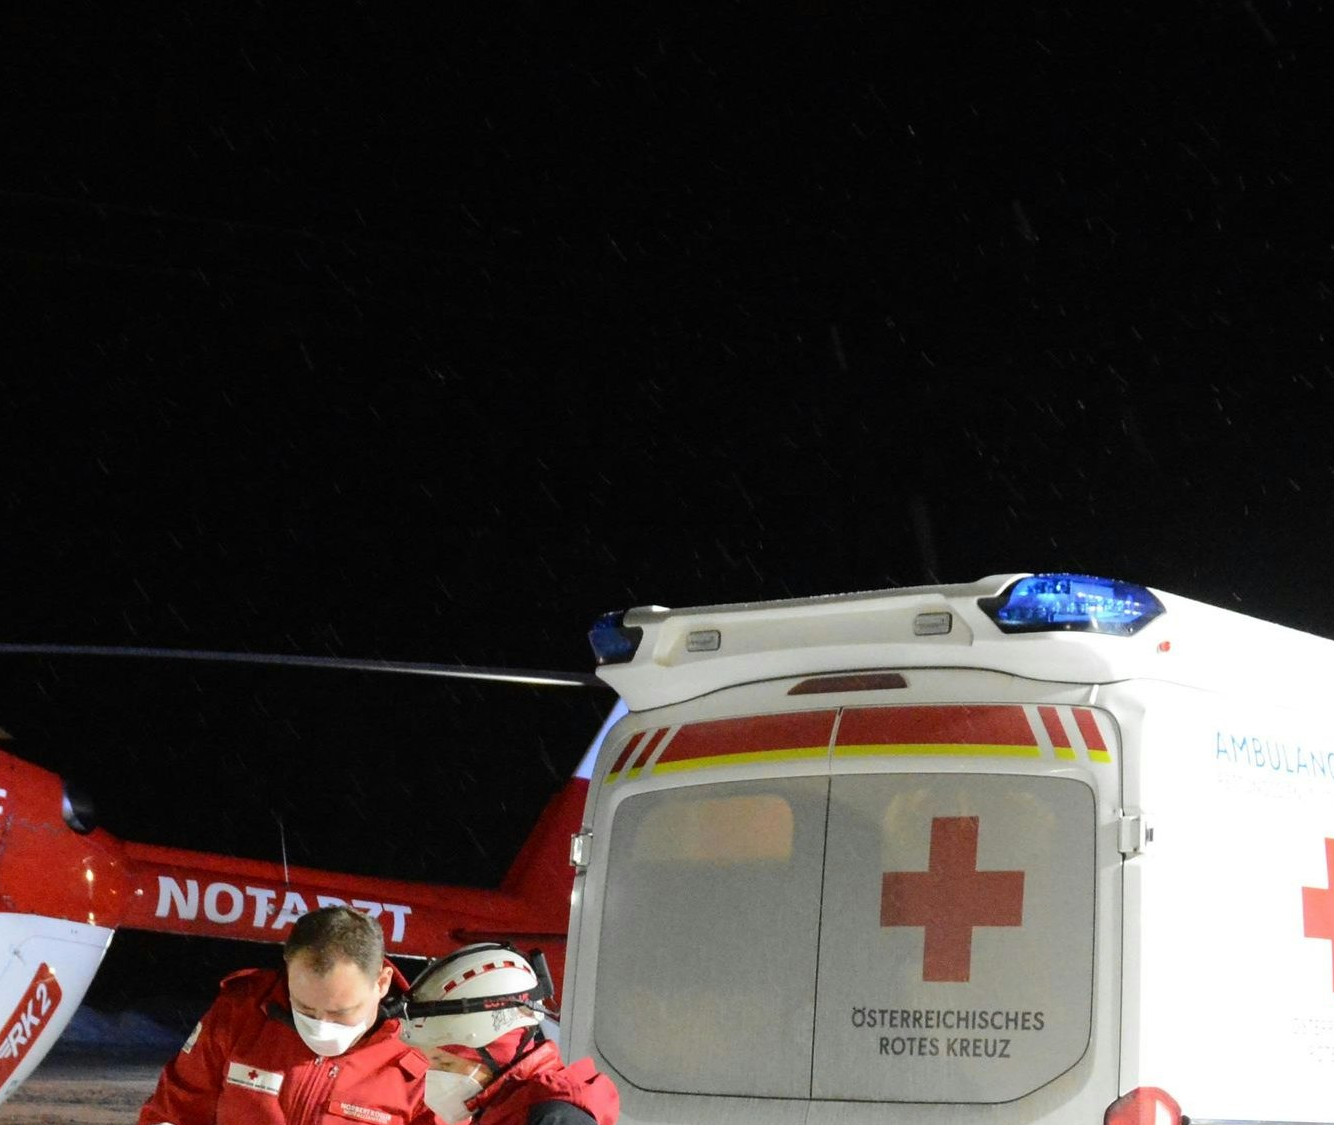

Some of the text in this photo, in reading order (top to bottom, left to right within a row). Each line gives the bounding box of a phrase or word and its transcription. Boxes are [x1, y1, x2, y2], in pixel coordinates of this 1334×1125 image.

[851, 1006, 1045, 1031] ÖSTERREICHISCHES
[879, 1036, 1012, 1059] ROTES KREUZ
